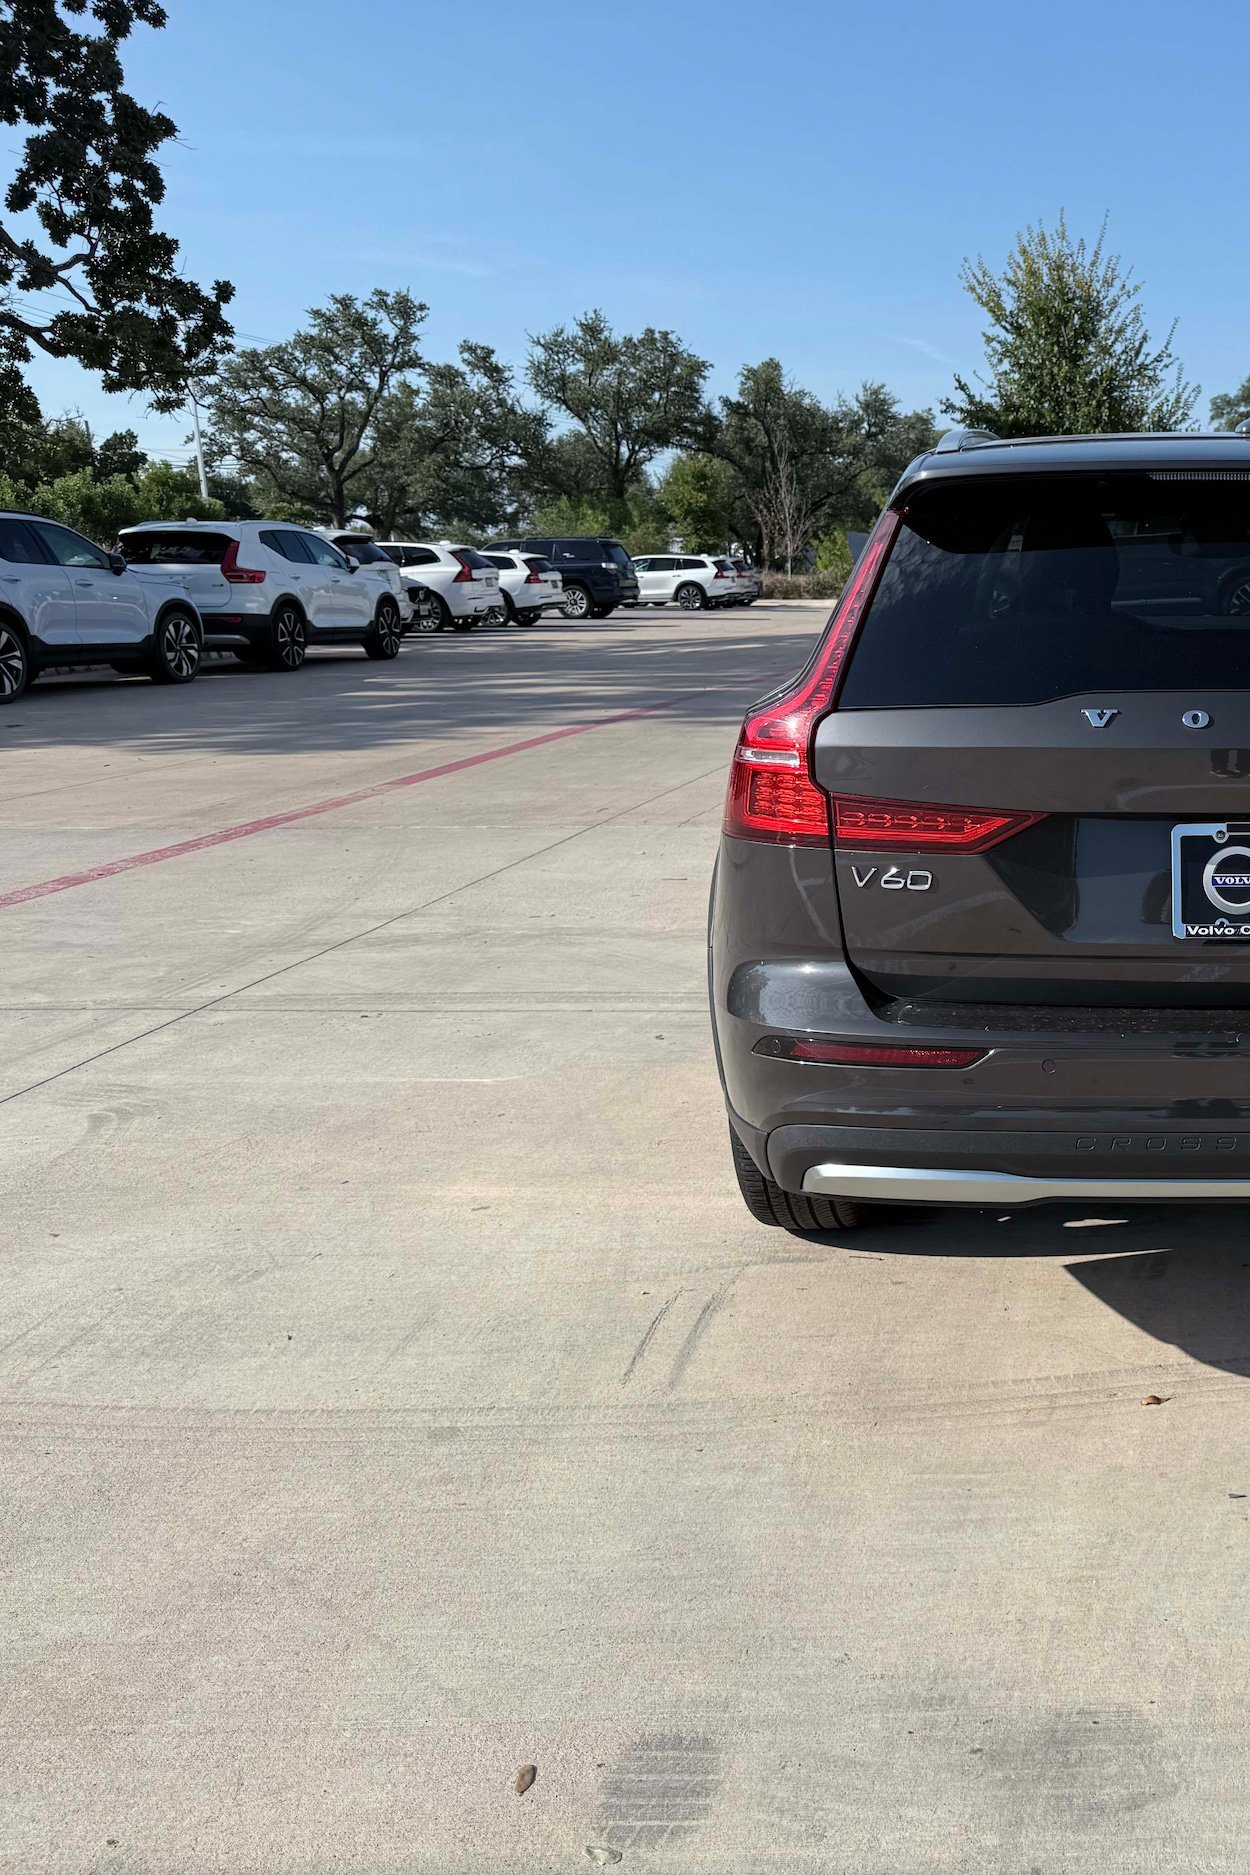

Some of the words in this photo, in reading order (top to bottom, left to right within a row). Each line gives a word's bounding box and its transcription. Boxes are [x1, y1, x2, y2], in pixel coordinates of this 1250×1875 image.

[851, 866, 933, 891] V60
[1186, 924, 1236, 936] Volvo
[1074, 1136, 1238, 1151] CROSS
